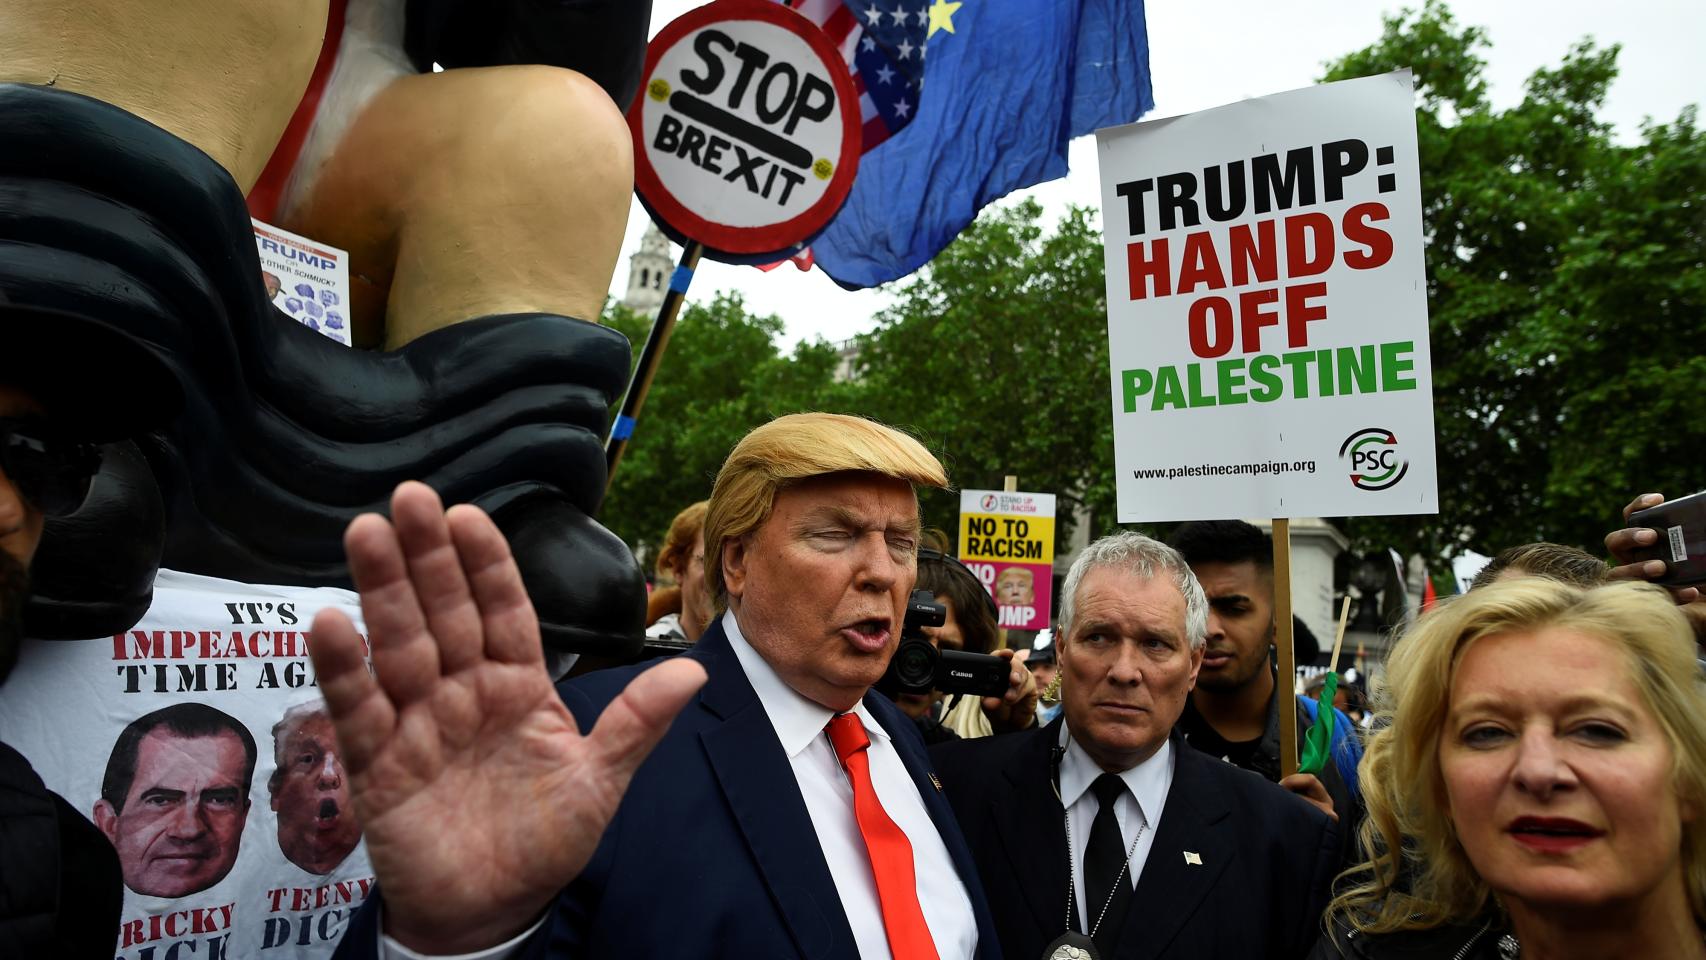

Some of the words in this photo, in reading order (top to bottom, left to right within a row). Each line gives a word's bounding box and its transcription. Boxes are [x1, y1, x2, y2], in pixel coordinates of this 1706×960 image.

[680, 29, 835, 136] STOP
[654, 115, 806, 206] BREXIT
[1116, 138, 1397, 236] TRUMP:
[1126, 202, 1394, 301] HANDS
[267, 259, 292, 274] OTHER
[294, 270, 336, 288] SCHMUCK?
[1188, 281, 1328, 359] OFF
[1121, 341, 1417, 414] PALESTINE
[1133, 459, 1316, 480] www.palestinecampaign.org
[1351, 449, 1396, 471] PSC
[1000, 496, 1022, 504] STAND
[1011, 505, 1037, 513] RACISM
[968, 517, 997, 537] NO
[1003, 519, 1029, 538] TO
[967, 537, 1043, 559] RACISM
[916, 604, 936, 612] Canon
[112, 630, 370, 661] IMPEACH
[117, 663, 238, 693] TIME
[950, 670, 973, 679] Canon
[267, 877, 376, 913] TEENY
[119, 902, 236, 949] RICKY
[260, 906, 358, 950] DIC
